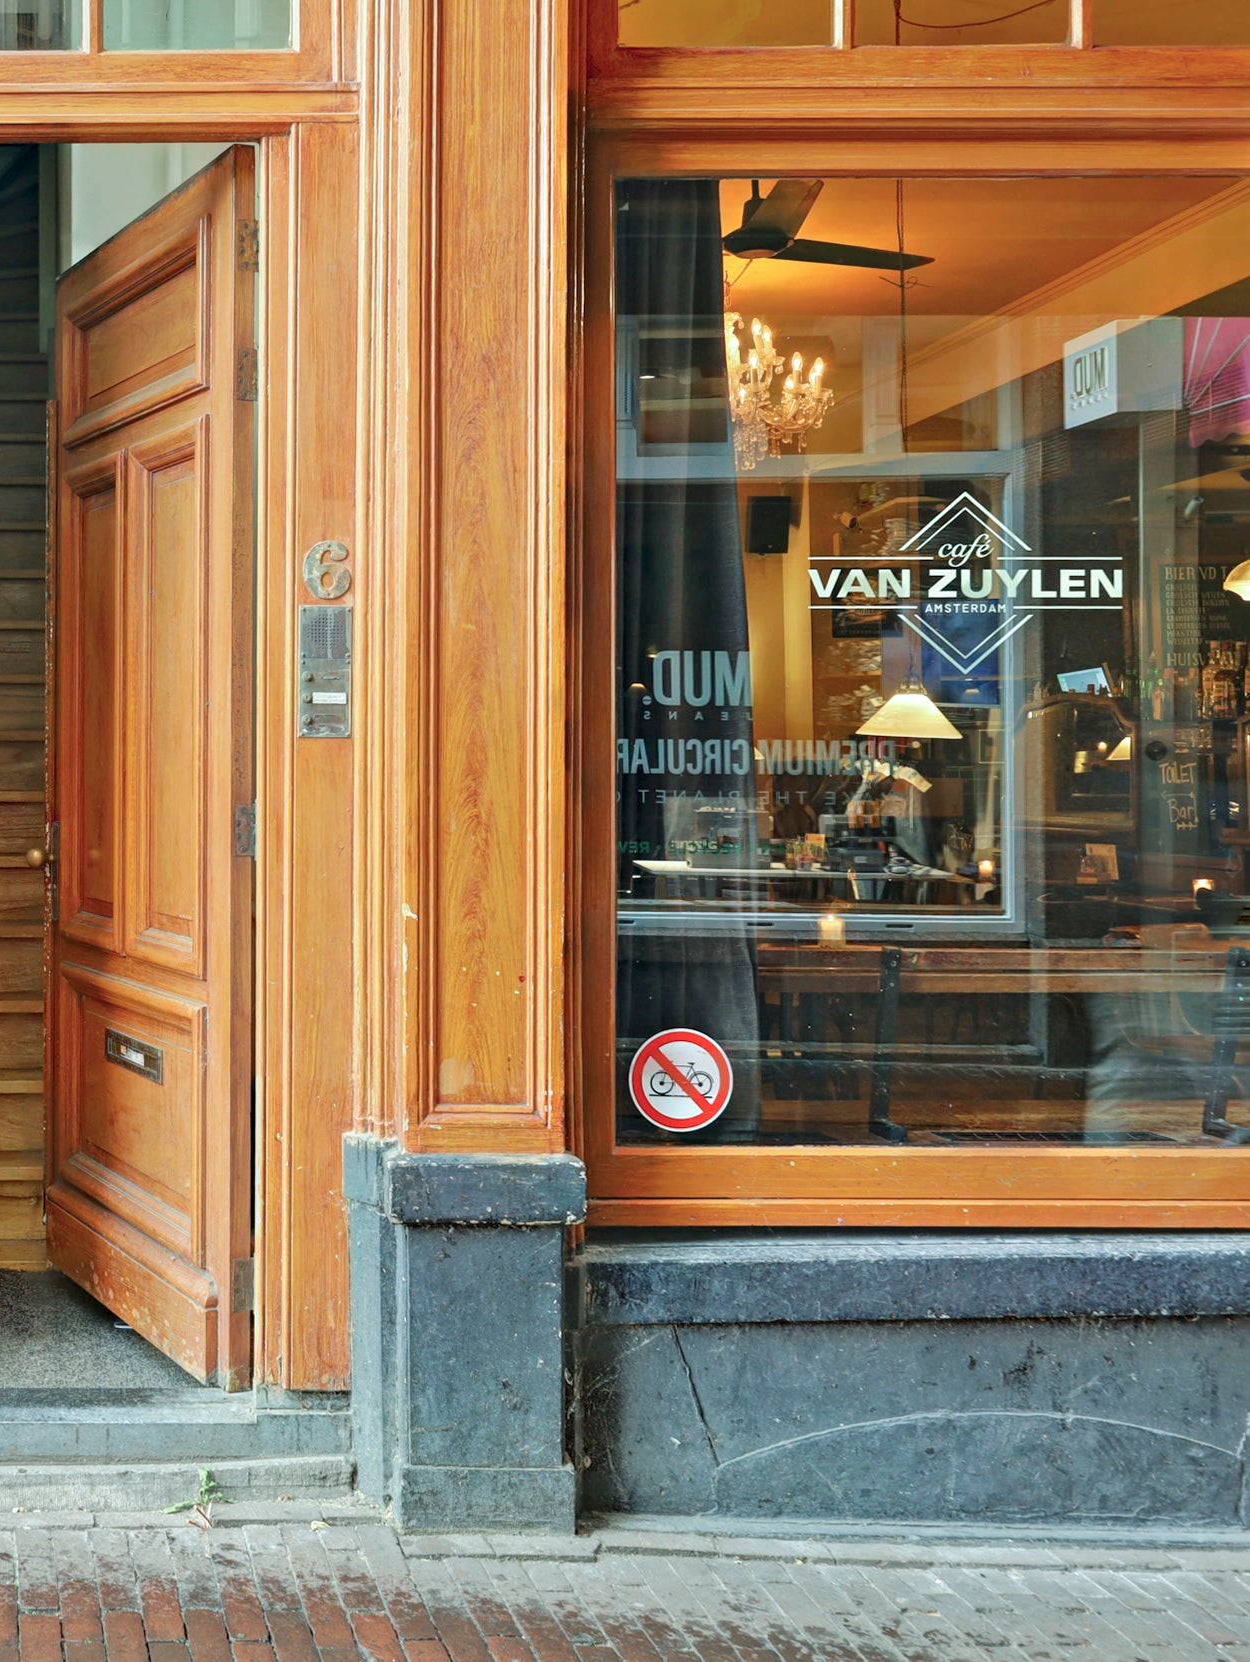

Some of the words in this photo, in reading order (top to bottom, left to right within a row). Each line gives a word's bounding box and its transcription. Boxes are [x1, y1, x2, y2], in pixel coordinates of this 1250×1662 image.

[937, 533, 994, 568] café
[303, 539, 352, 599] 6
[807, 569, 911, 598] VAN
[928, 569, 1123, 598] ZUYLEN
[1165, 566, 1196, 580] BIER
[924, 603, 1007, 614] AMSTERDAM
